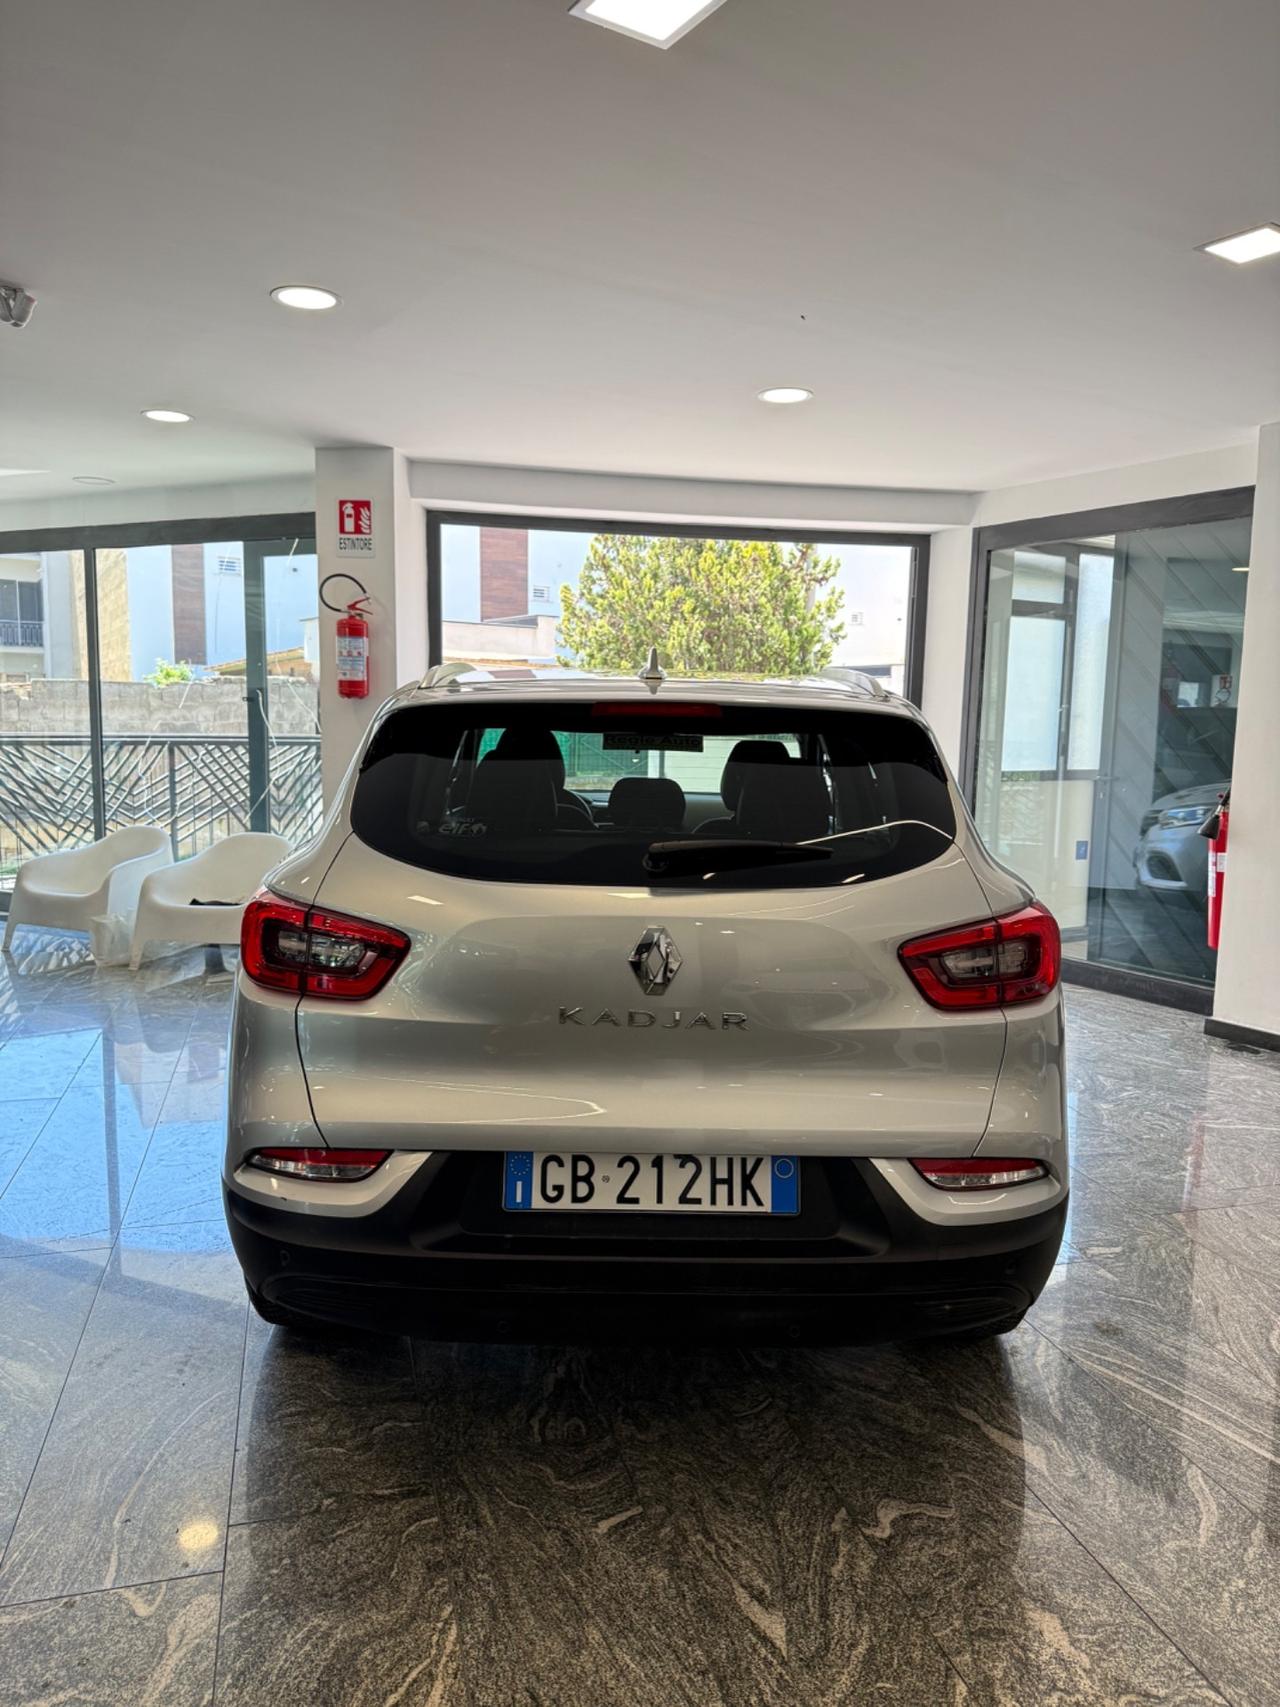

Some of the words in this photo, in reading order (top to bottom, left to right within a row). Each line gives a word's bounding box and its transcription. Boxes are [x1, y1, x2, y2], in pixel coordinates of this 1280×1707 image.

[339, 537, 372, 551] ESTINTORE
[559, 1007, 751, 1031] KADJAR
[516, 1181, 523, 1203] I
[540, 1154, 595, 1204] GB
